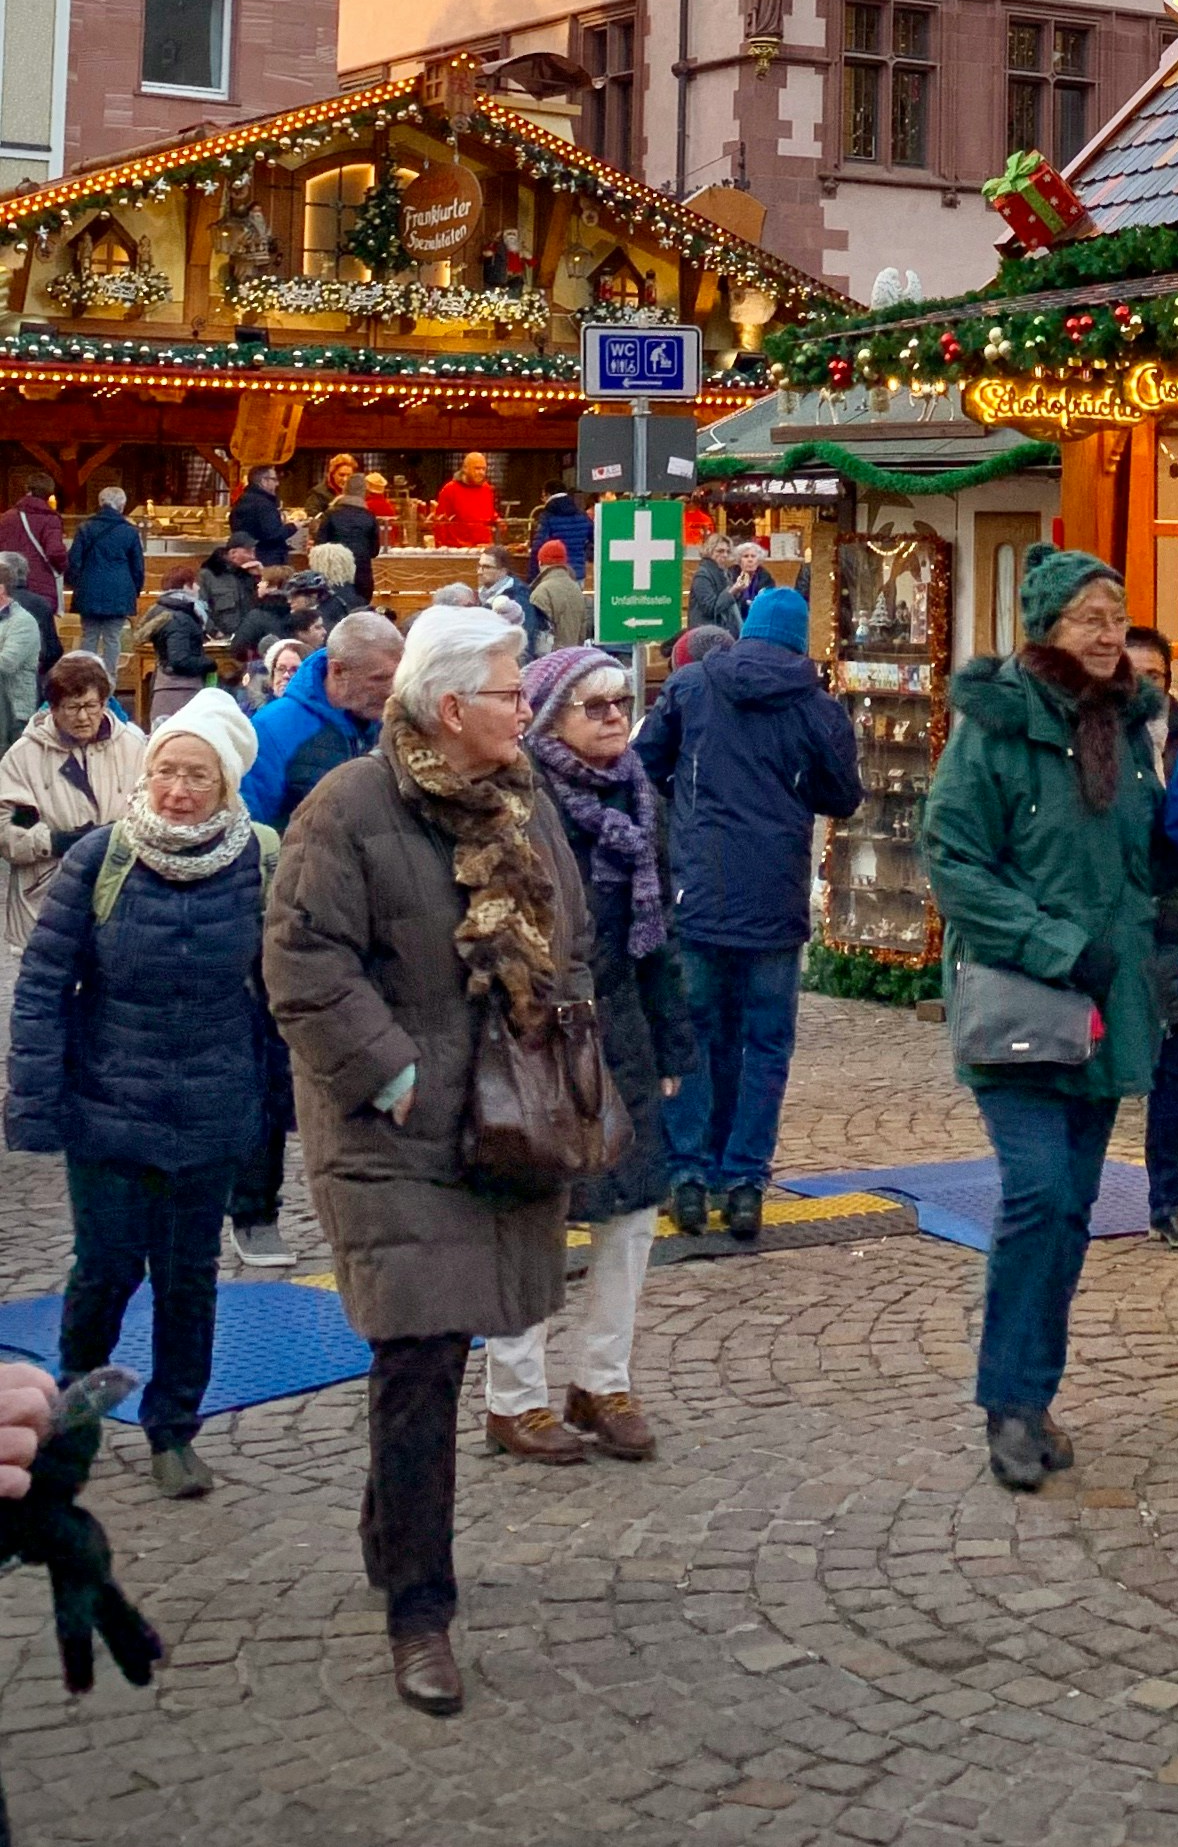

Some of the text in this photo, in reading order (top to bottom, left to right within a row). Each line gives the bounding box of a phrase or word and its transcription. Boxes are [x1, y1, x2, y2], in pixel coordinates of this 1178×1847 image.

[403, 197, 472, 236] Frankfurter
[407, 225, 467, 251] Spezialitäten
[610, 343, 635, 357] WC
